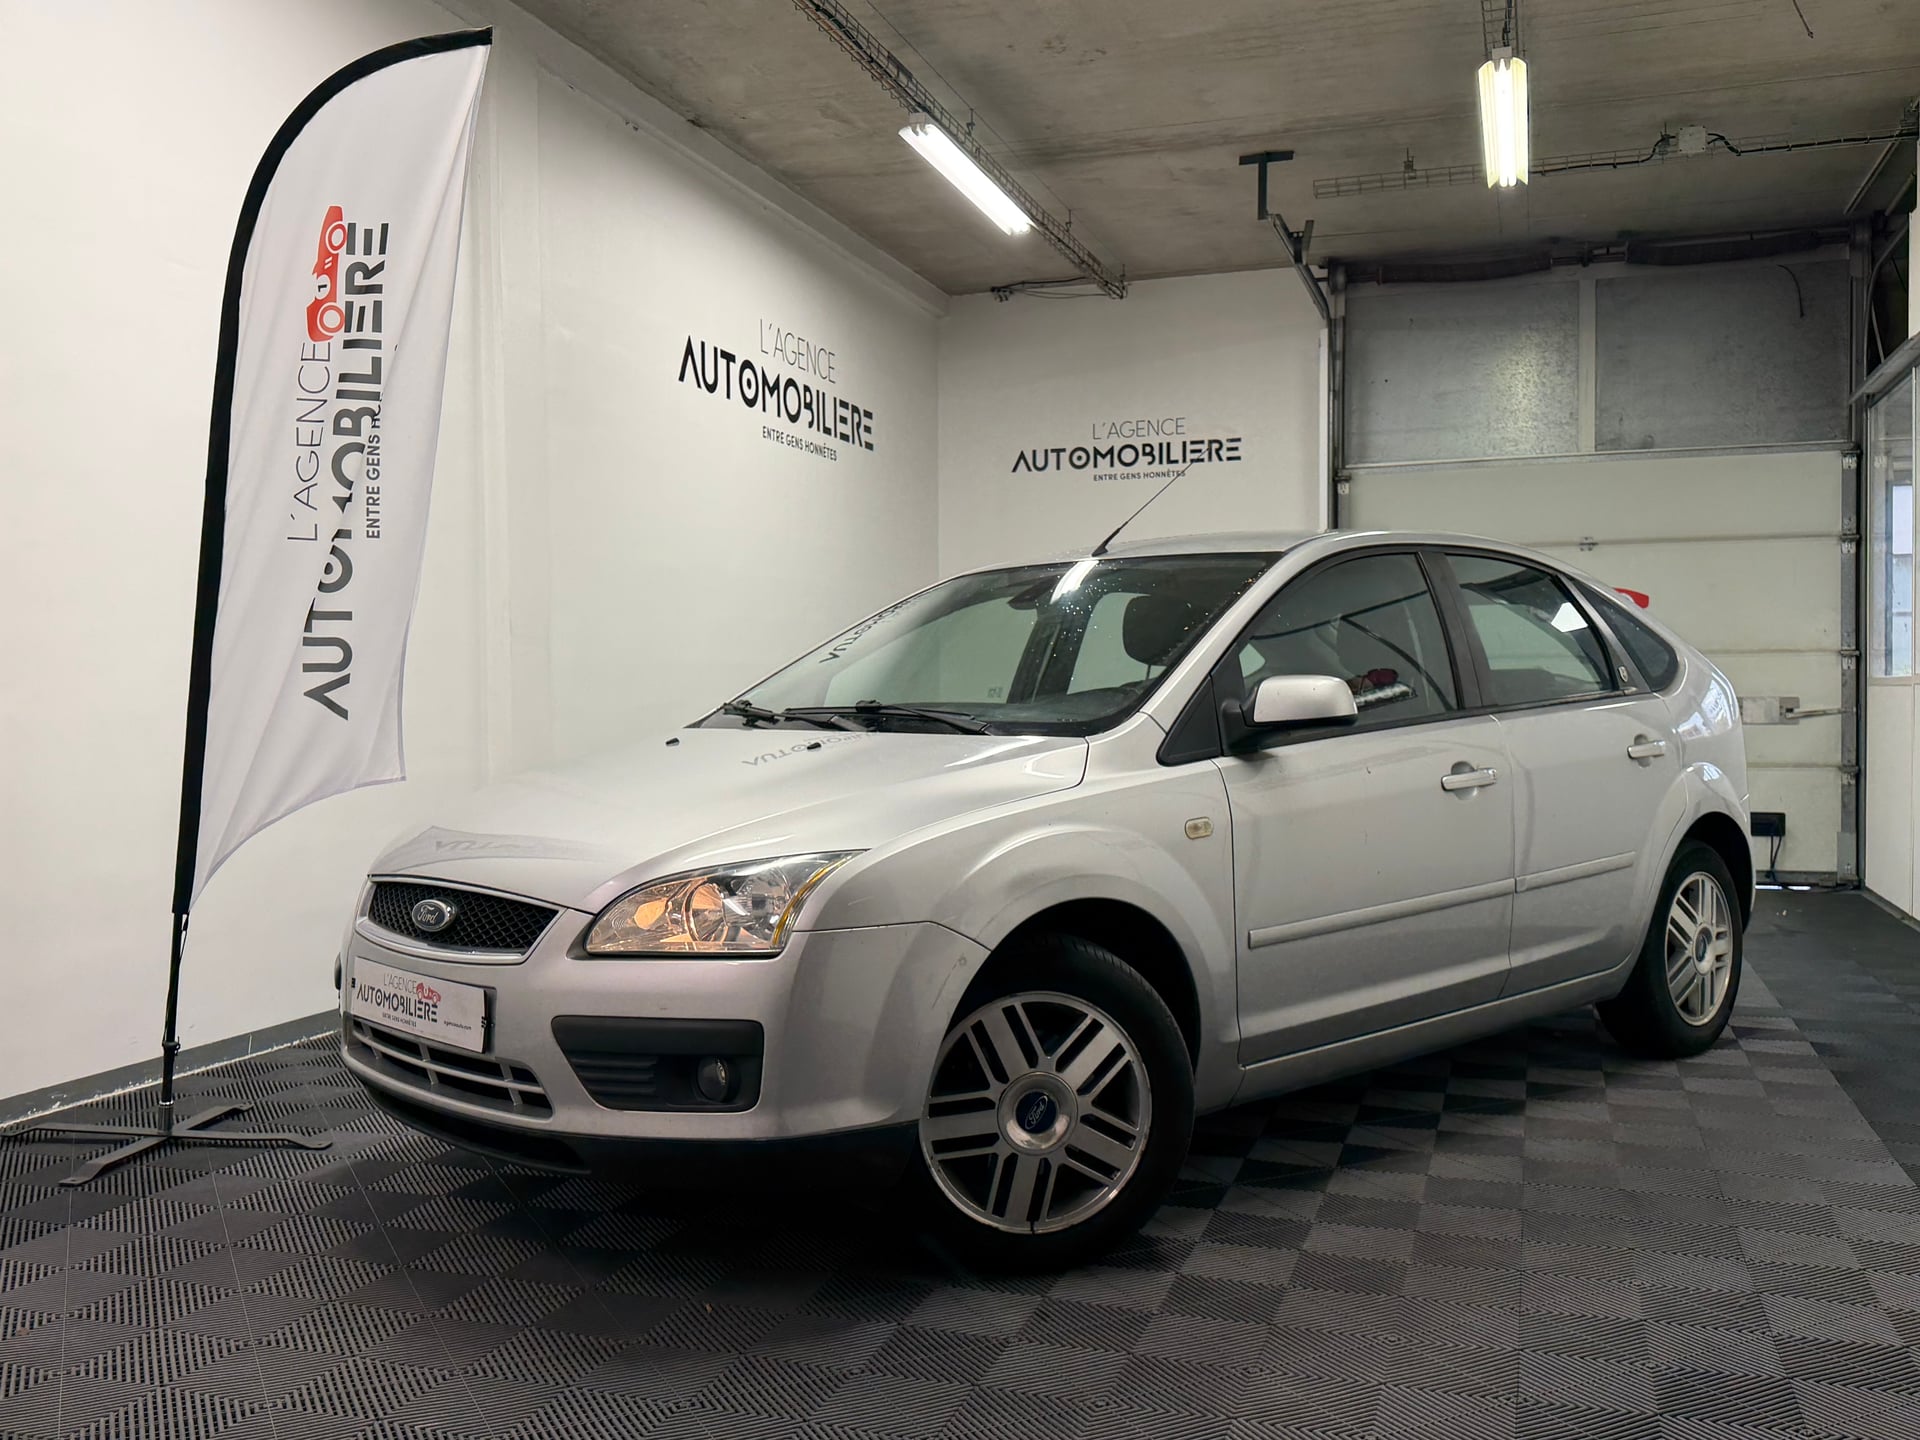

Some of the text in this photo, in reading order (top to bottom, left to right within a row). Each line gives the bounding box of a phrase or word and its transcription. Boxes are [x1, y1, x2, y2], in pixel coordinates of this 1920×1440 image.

[760, 319, 836, 384] L'AGENCE
[678, 335, 874, 452] AUTOMOBILIERE
[287, 341, 331, 541] L'AGENCE
[762, 425, 838, 462] ENTRE GENS HONNÊTES
[1092, 417, 1186, 440] L'AGENCE
[1011, 437, 1242, 473] AUTOMOBILIERE
[366, 434, 381, 539] ENTRE GENS
[1093, 469, 1186, 482] ENTRE GENS HONNÊTES
[383, 972, 417, 995] L'AGENCE
[356, 983, 438, 1023] AUTOMOBILIERE
